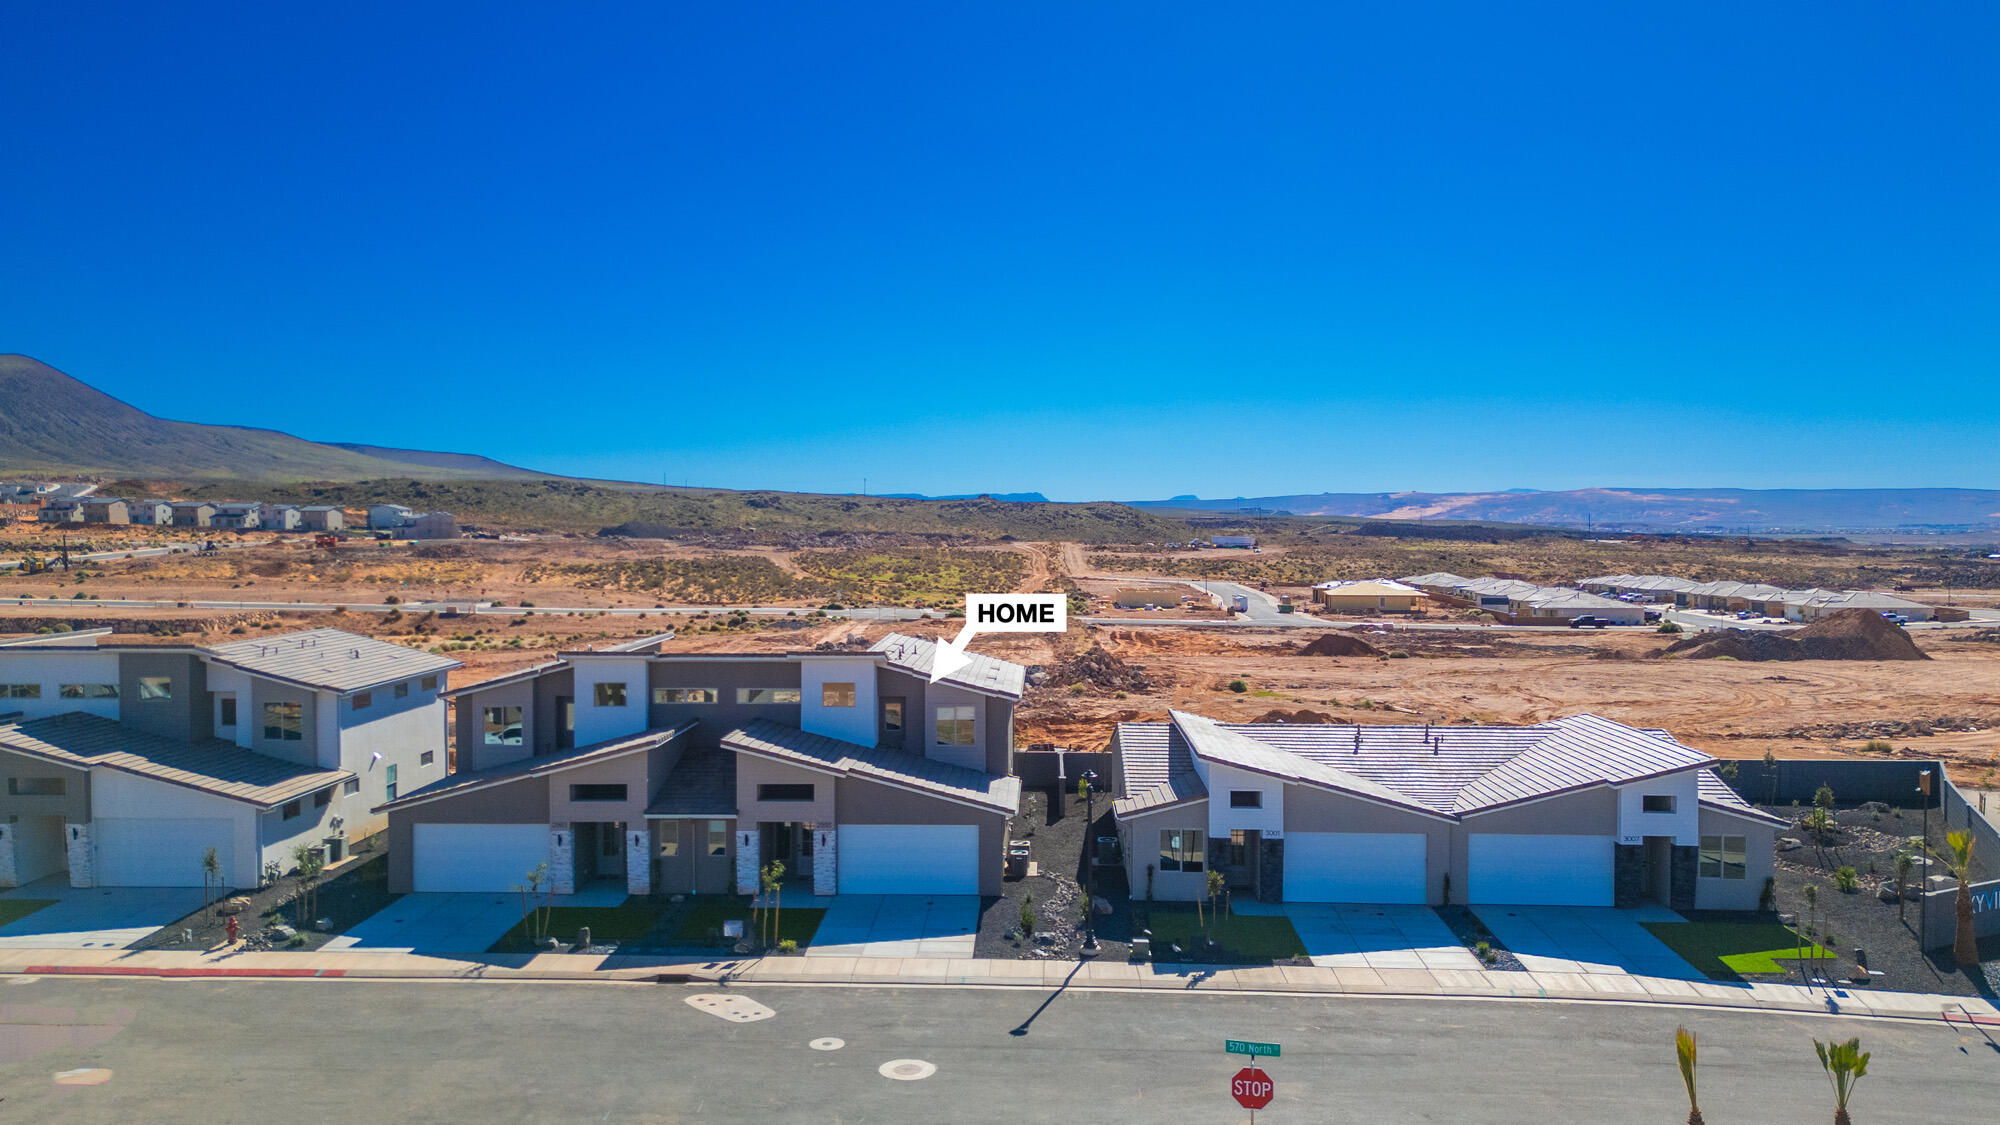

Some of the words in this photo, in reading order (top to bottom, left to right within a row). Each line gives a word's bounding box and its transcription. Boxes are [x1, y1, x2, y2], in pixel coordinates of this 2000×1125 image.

[1229, 1042, 1245, 1052] 570
[1248, 1044, 1272, 1054] North
[1234, 1080, 1271, 1097] STOP
